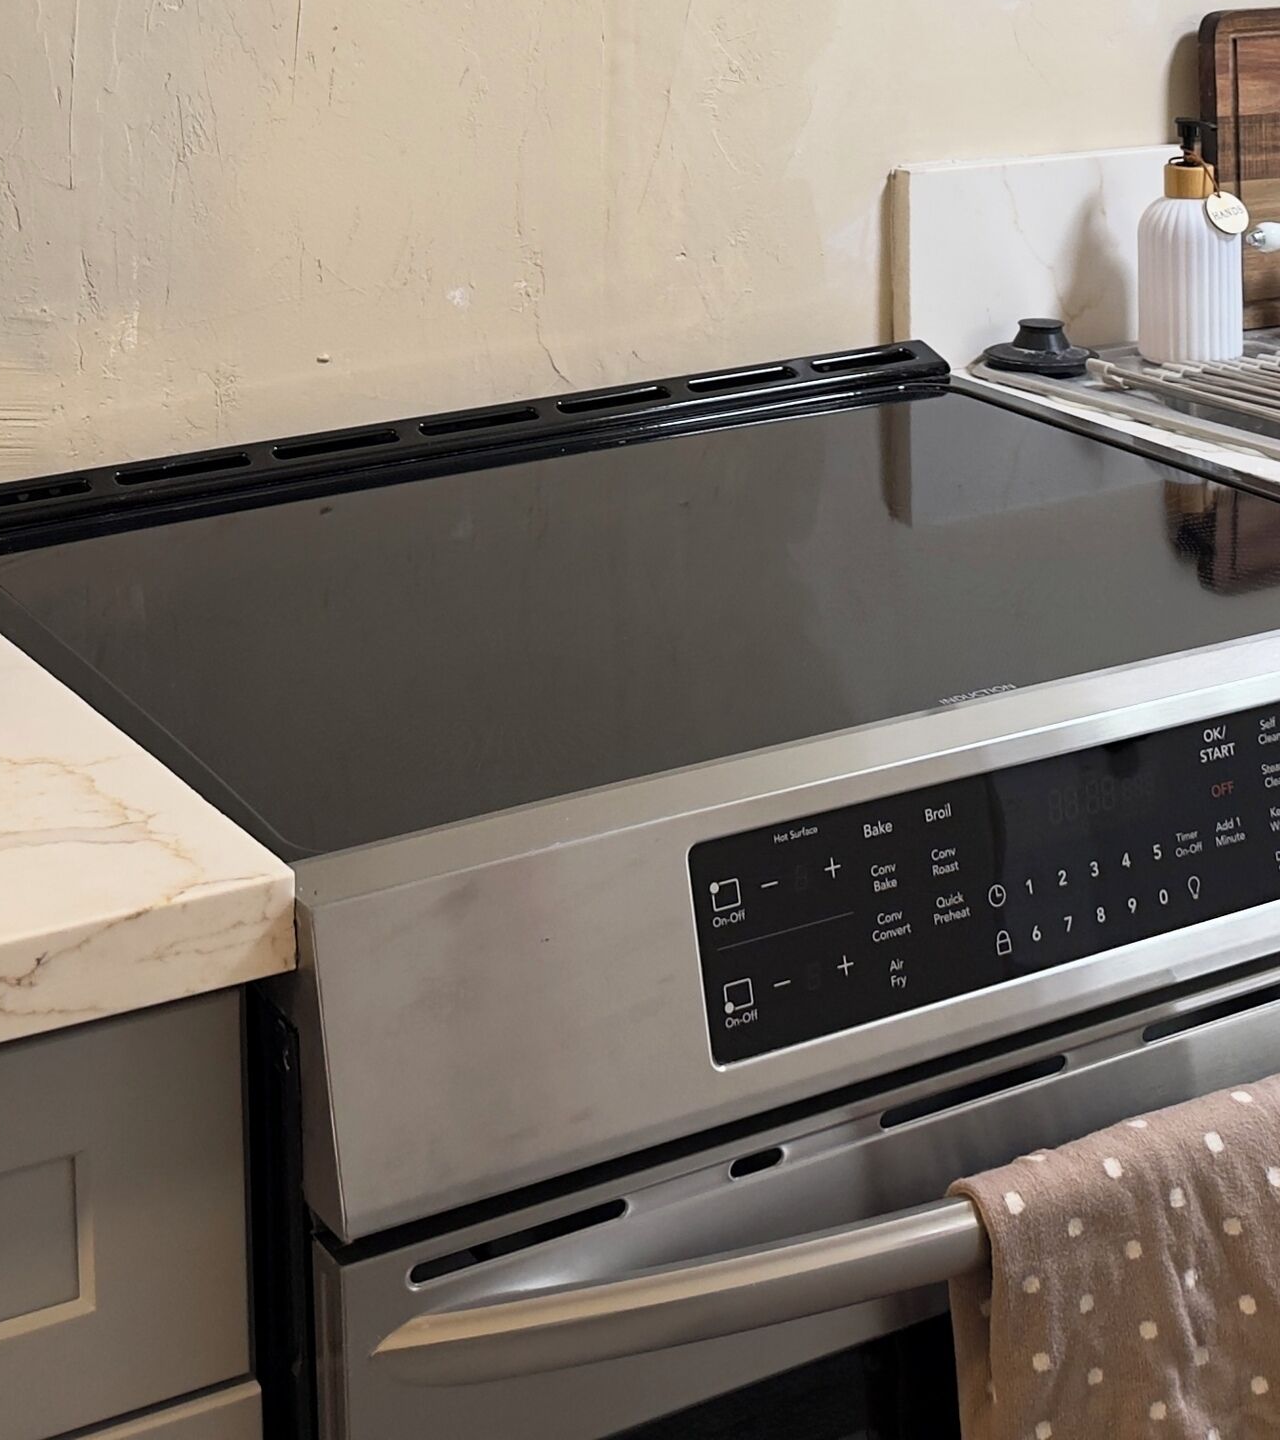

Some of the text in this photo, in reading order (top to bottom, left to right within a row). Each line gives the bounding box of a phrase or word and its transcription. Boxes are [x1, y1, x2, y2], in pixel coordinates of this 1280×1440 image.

[937, 682, 1017, 705] INDUCTION
[1259, 716, 1276, 731] Self
[1203, 724, 1226, 743] OK/
[1199, 742, 1236, 763] START
[1211, 780, 1235, 798] OFF
[924, 802, 952, 823] Broil
[863, 820, 893, 839] Bake
[1216, 816, 1241, 833] Add 1
[773, 826, 818, 844] Hot Surface
[1175, 830, 1199, 843] Timer
[1215, 831, 1246, 848] Minute
[931, 847, 957, 861] Conv
[1175, 841, 1203, 858] On-Off
[870, 863, 896, 877] Conv
[932, 861, 960, 876] Roast
[1025, 844, 1162, 895] 1 2 3 4 5
[873, 877, 898, 892] Bake
[936, 891, 964, 909] Quick
[712, 908, 746, 928] On-Off
[877, 910, 903, 925] Conv
[933, 906, 971, 925] Preheat
[1032, 888, 1169, 942] 6 7 8 9 0
[872, 923, 912, 942] Convert
[889, 958, 904, 973] Air
[890, 974, 907, 989] Fry
[725, 1008, 758, 1029] On-Off
